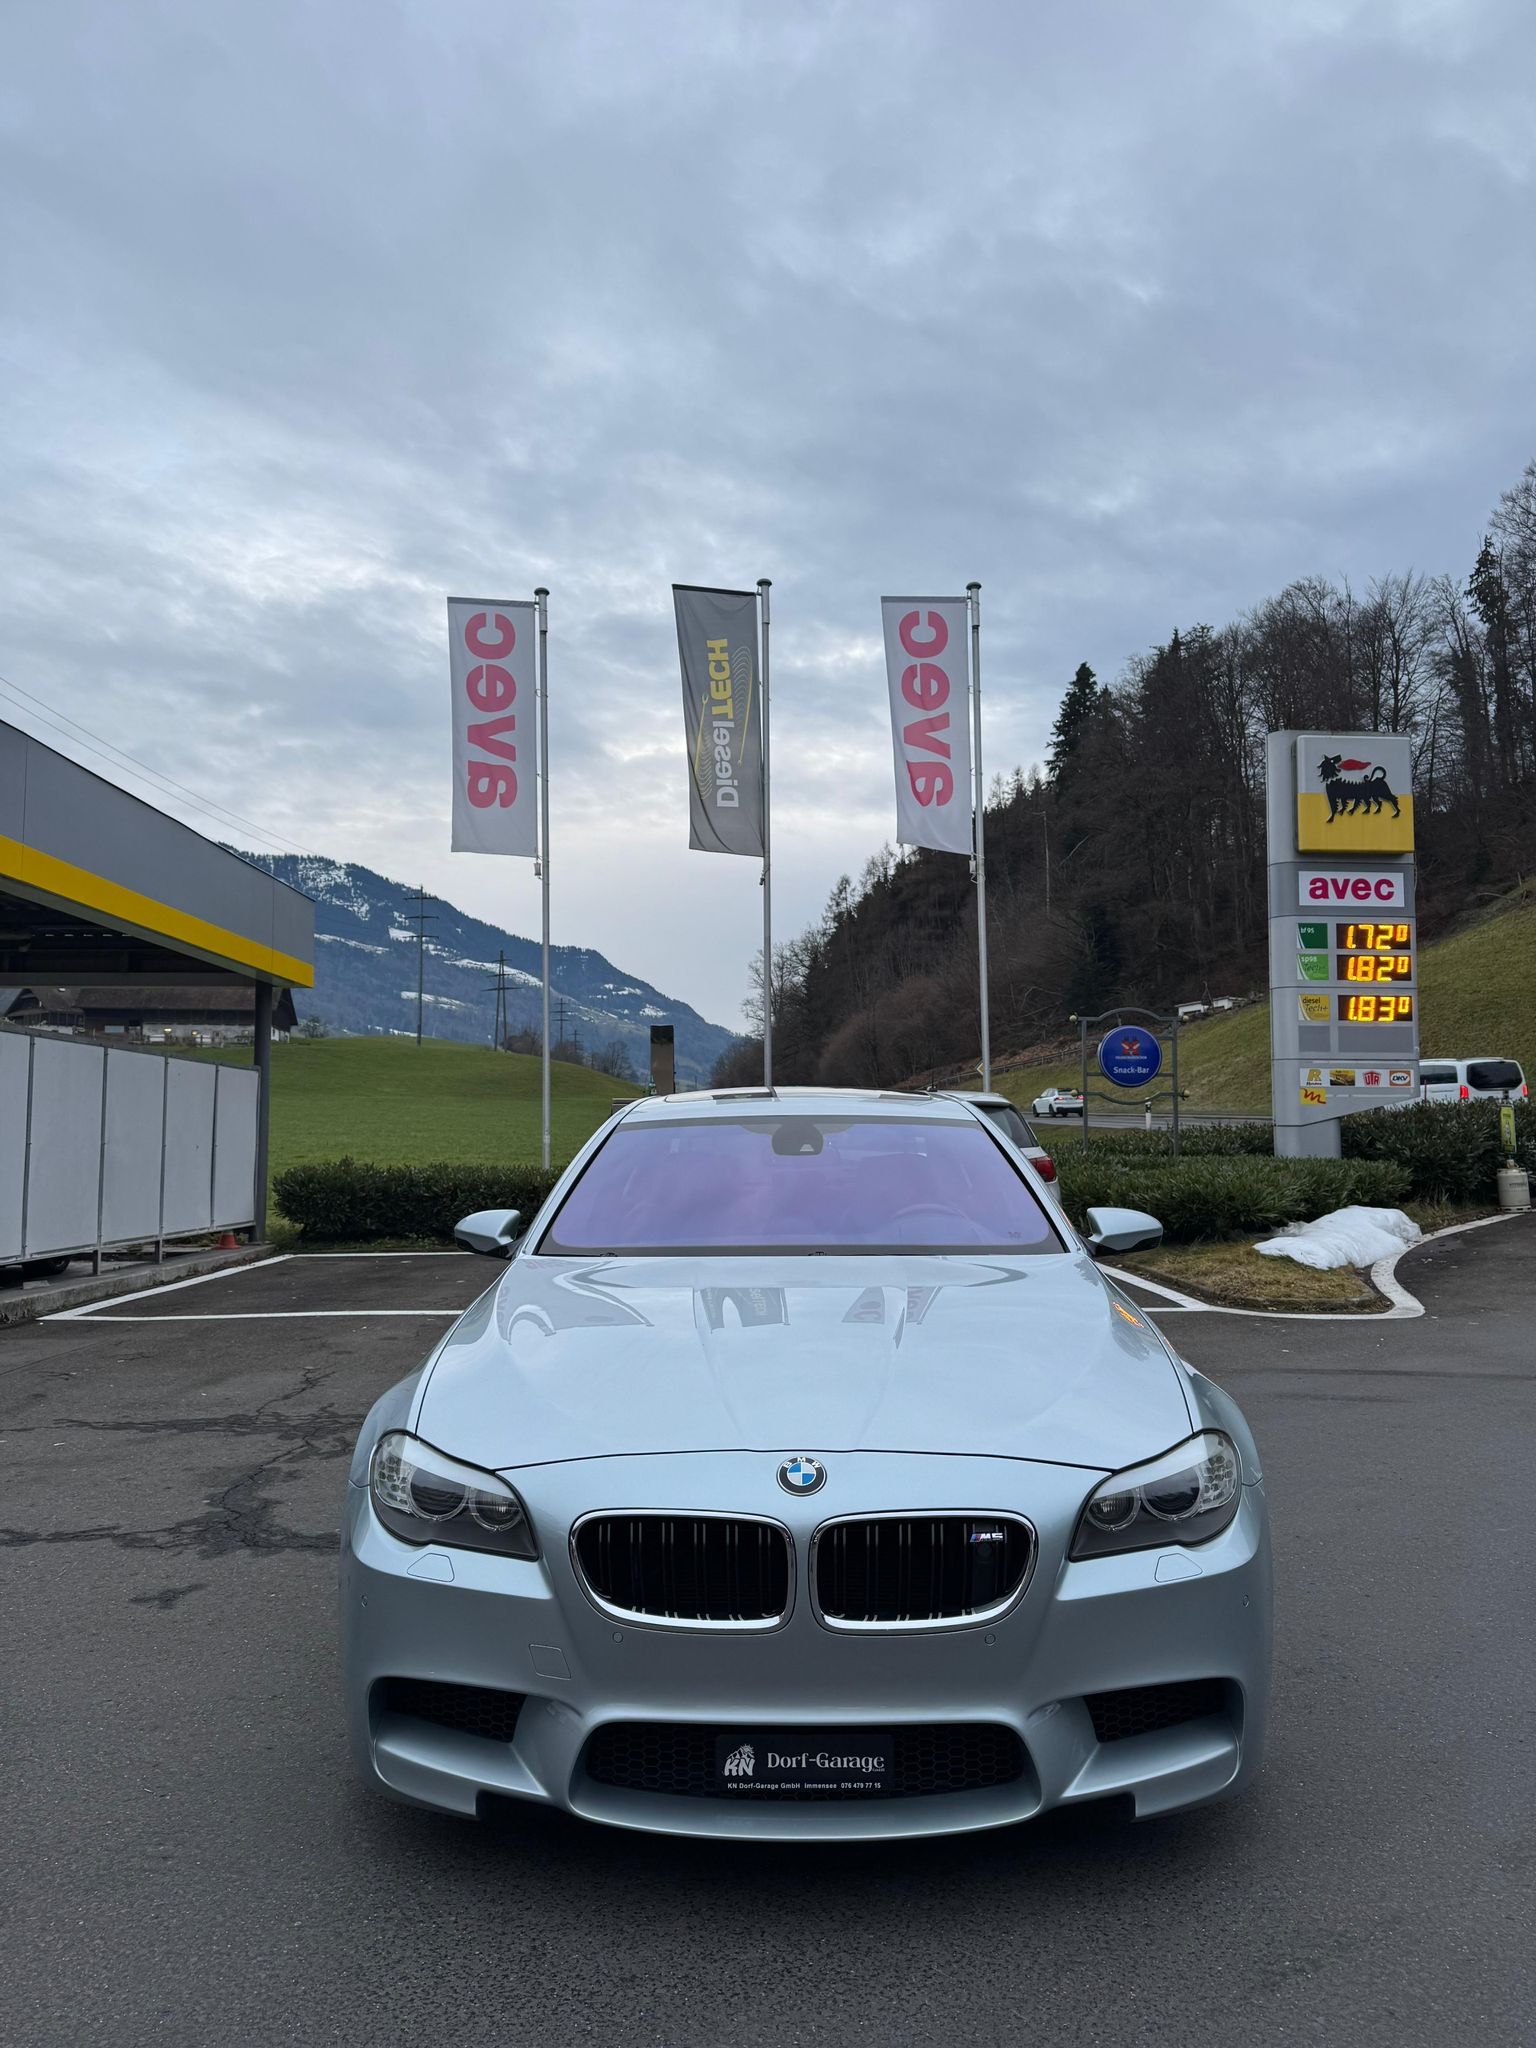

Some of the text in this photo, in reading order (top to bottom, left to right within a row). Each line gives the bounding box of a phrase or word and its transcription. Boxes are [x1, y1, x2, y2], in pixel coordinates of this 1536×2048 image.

[1308, 877, 1395, 901] avec
[1302, 996, 1321, 1004] diesel
[1113, 1066, 1150, 1074] Snack-Bar
[782, 1456, 821, 1468] BMW
[724, 1758, 756, 1777] KN
[767, 1752, 885, 1773] Dorf-Garage
[739, 1782, 779, 1790] Dorf-Garage
